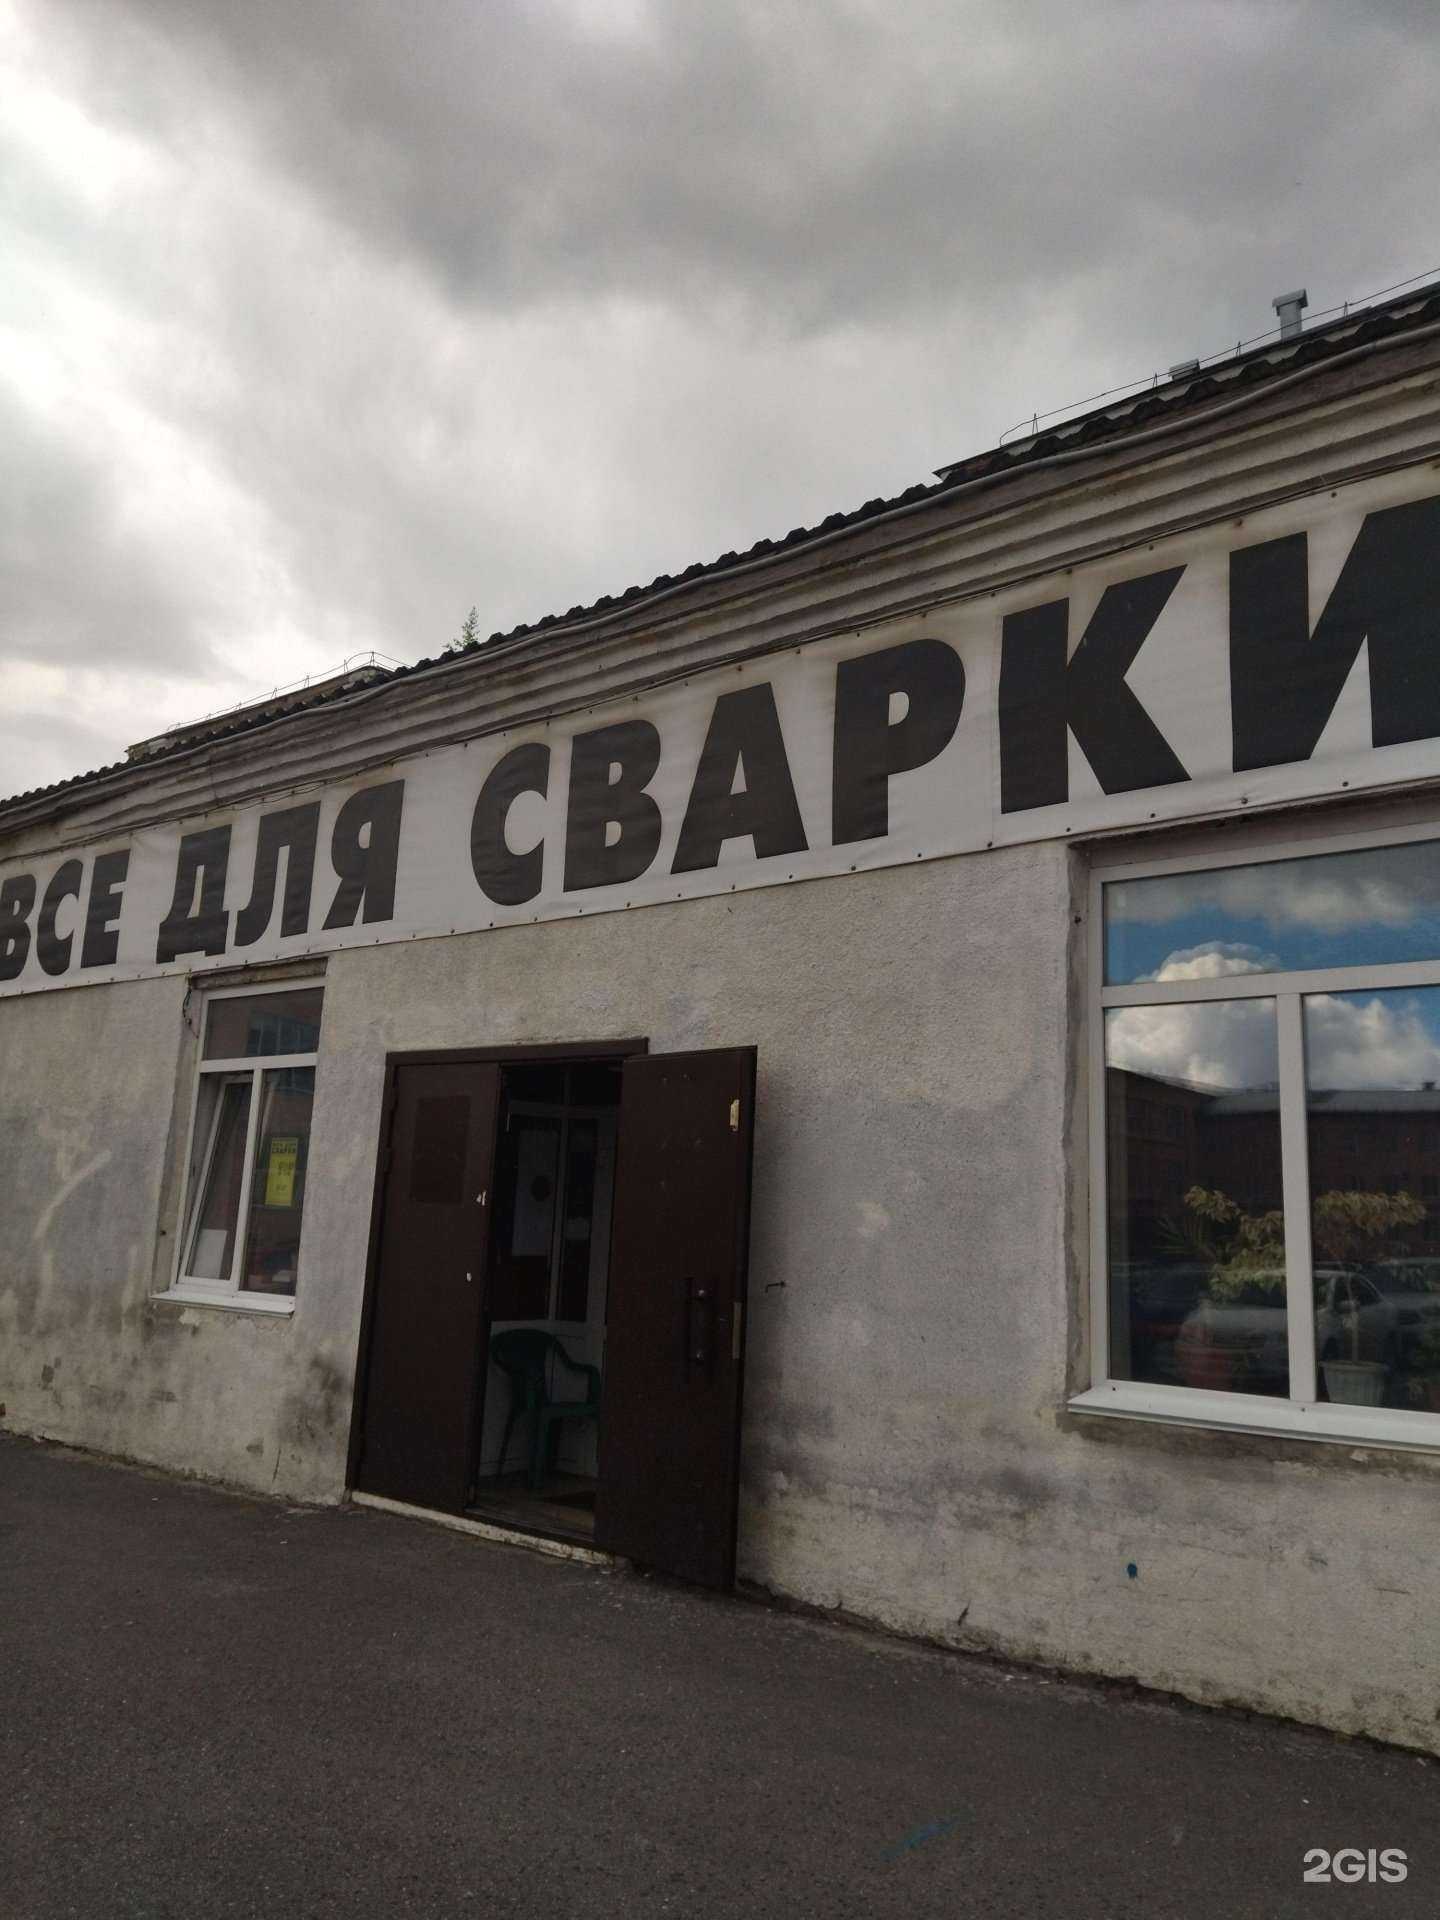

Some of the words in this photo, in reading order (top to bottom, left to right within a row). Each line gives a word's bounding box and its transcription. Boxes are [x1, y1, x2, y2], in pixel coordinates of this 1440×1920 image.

[0, 849, 131, 980] ВСЕ
[156, 779, 405, 964] ДЛЯ
[470, 495, 1440, 906] СВАРКИ
